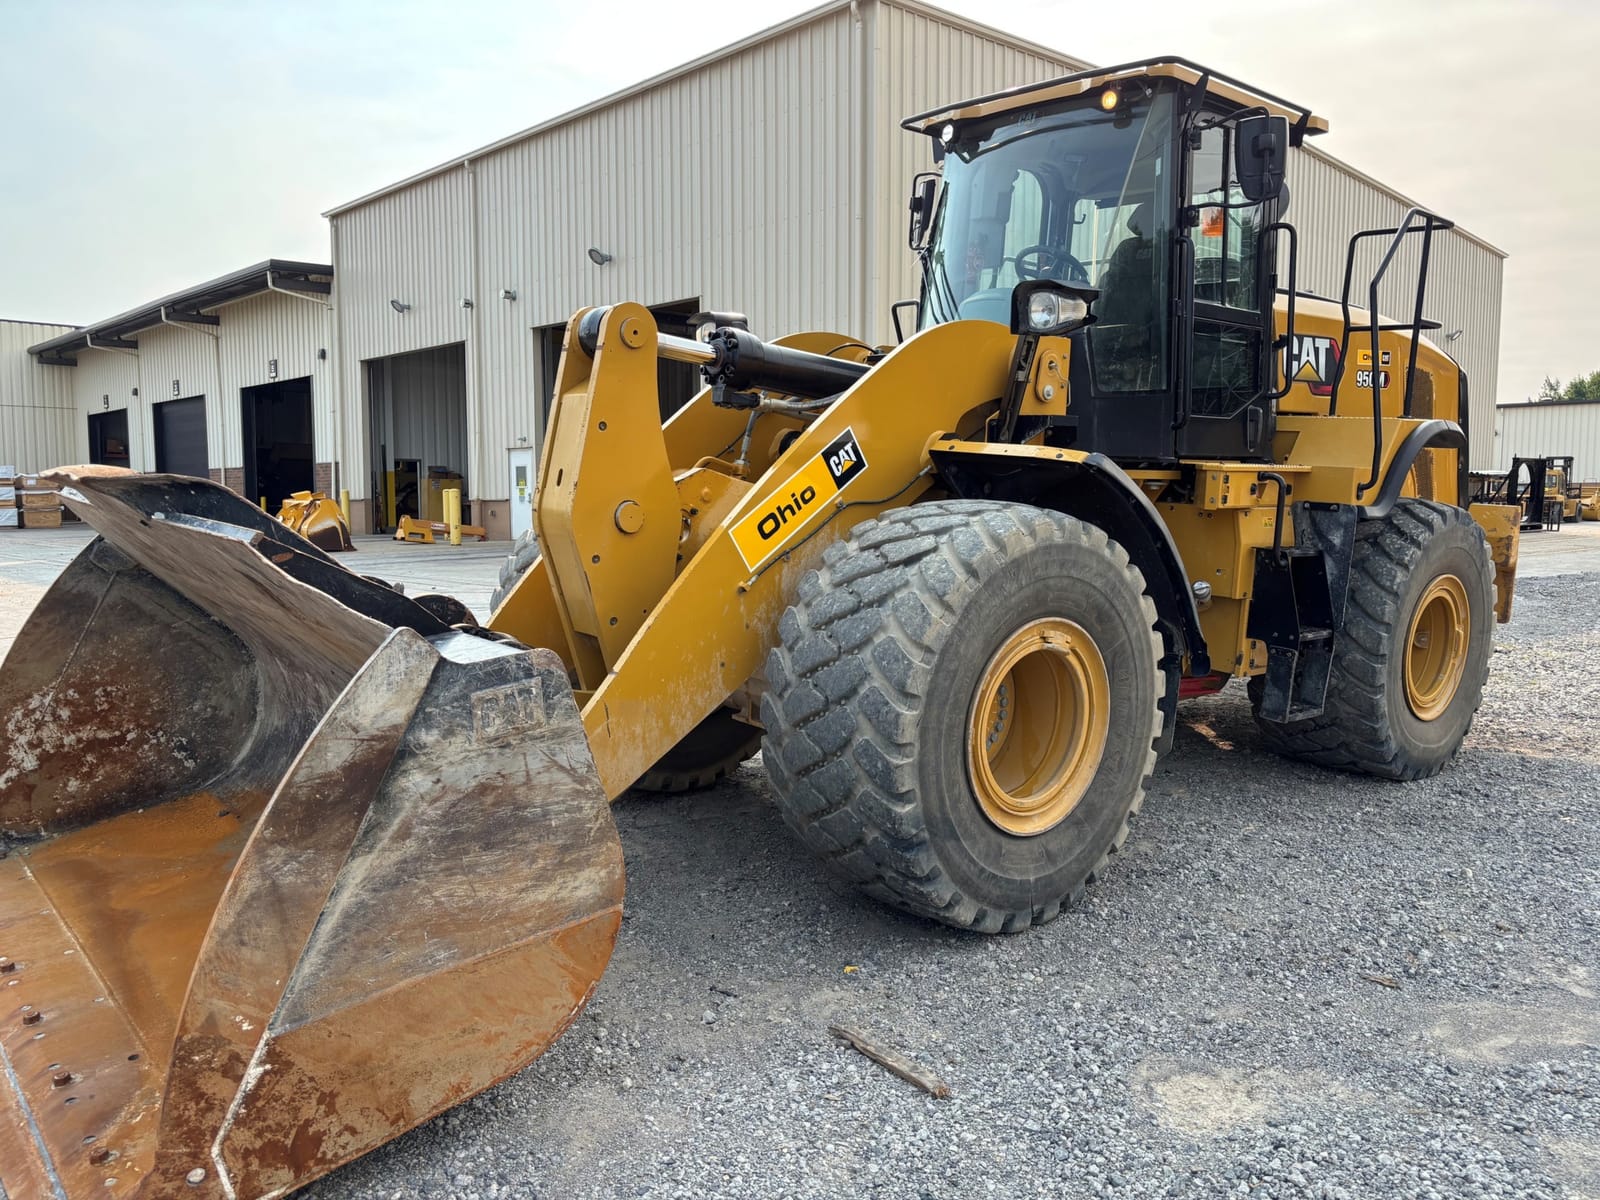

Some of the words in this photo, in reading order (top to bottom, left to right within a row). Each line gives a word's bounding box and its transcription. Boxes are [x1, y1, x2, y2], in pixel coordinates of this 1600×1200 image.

[1283, 336, 1330, 382] CAT
[757, 485, 816, 540] Ohio
[829, 441, 857, 477] CAT
